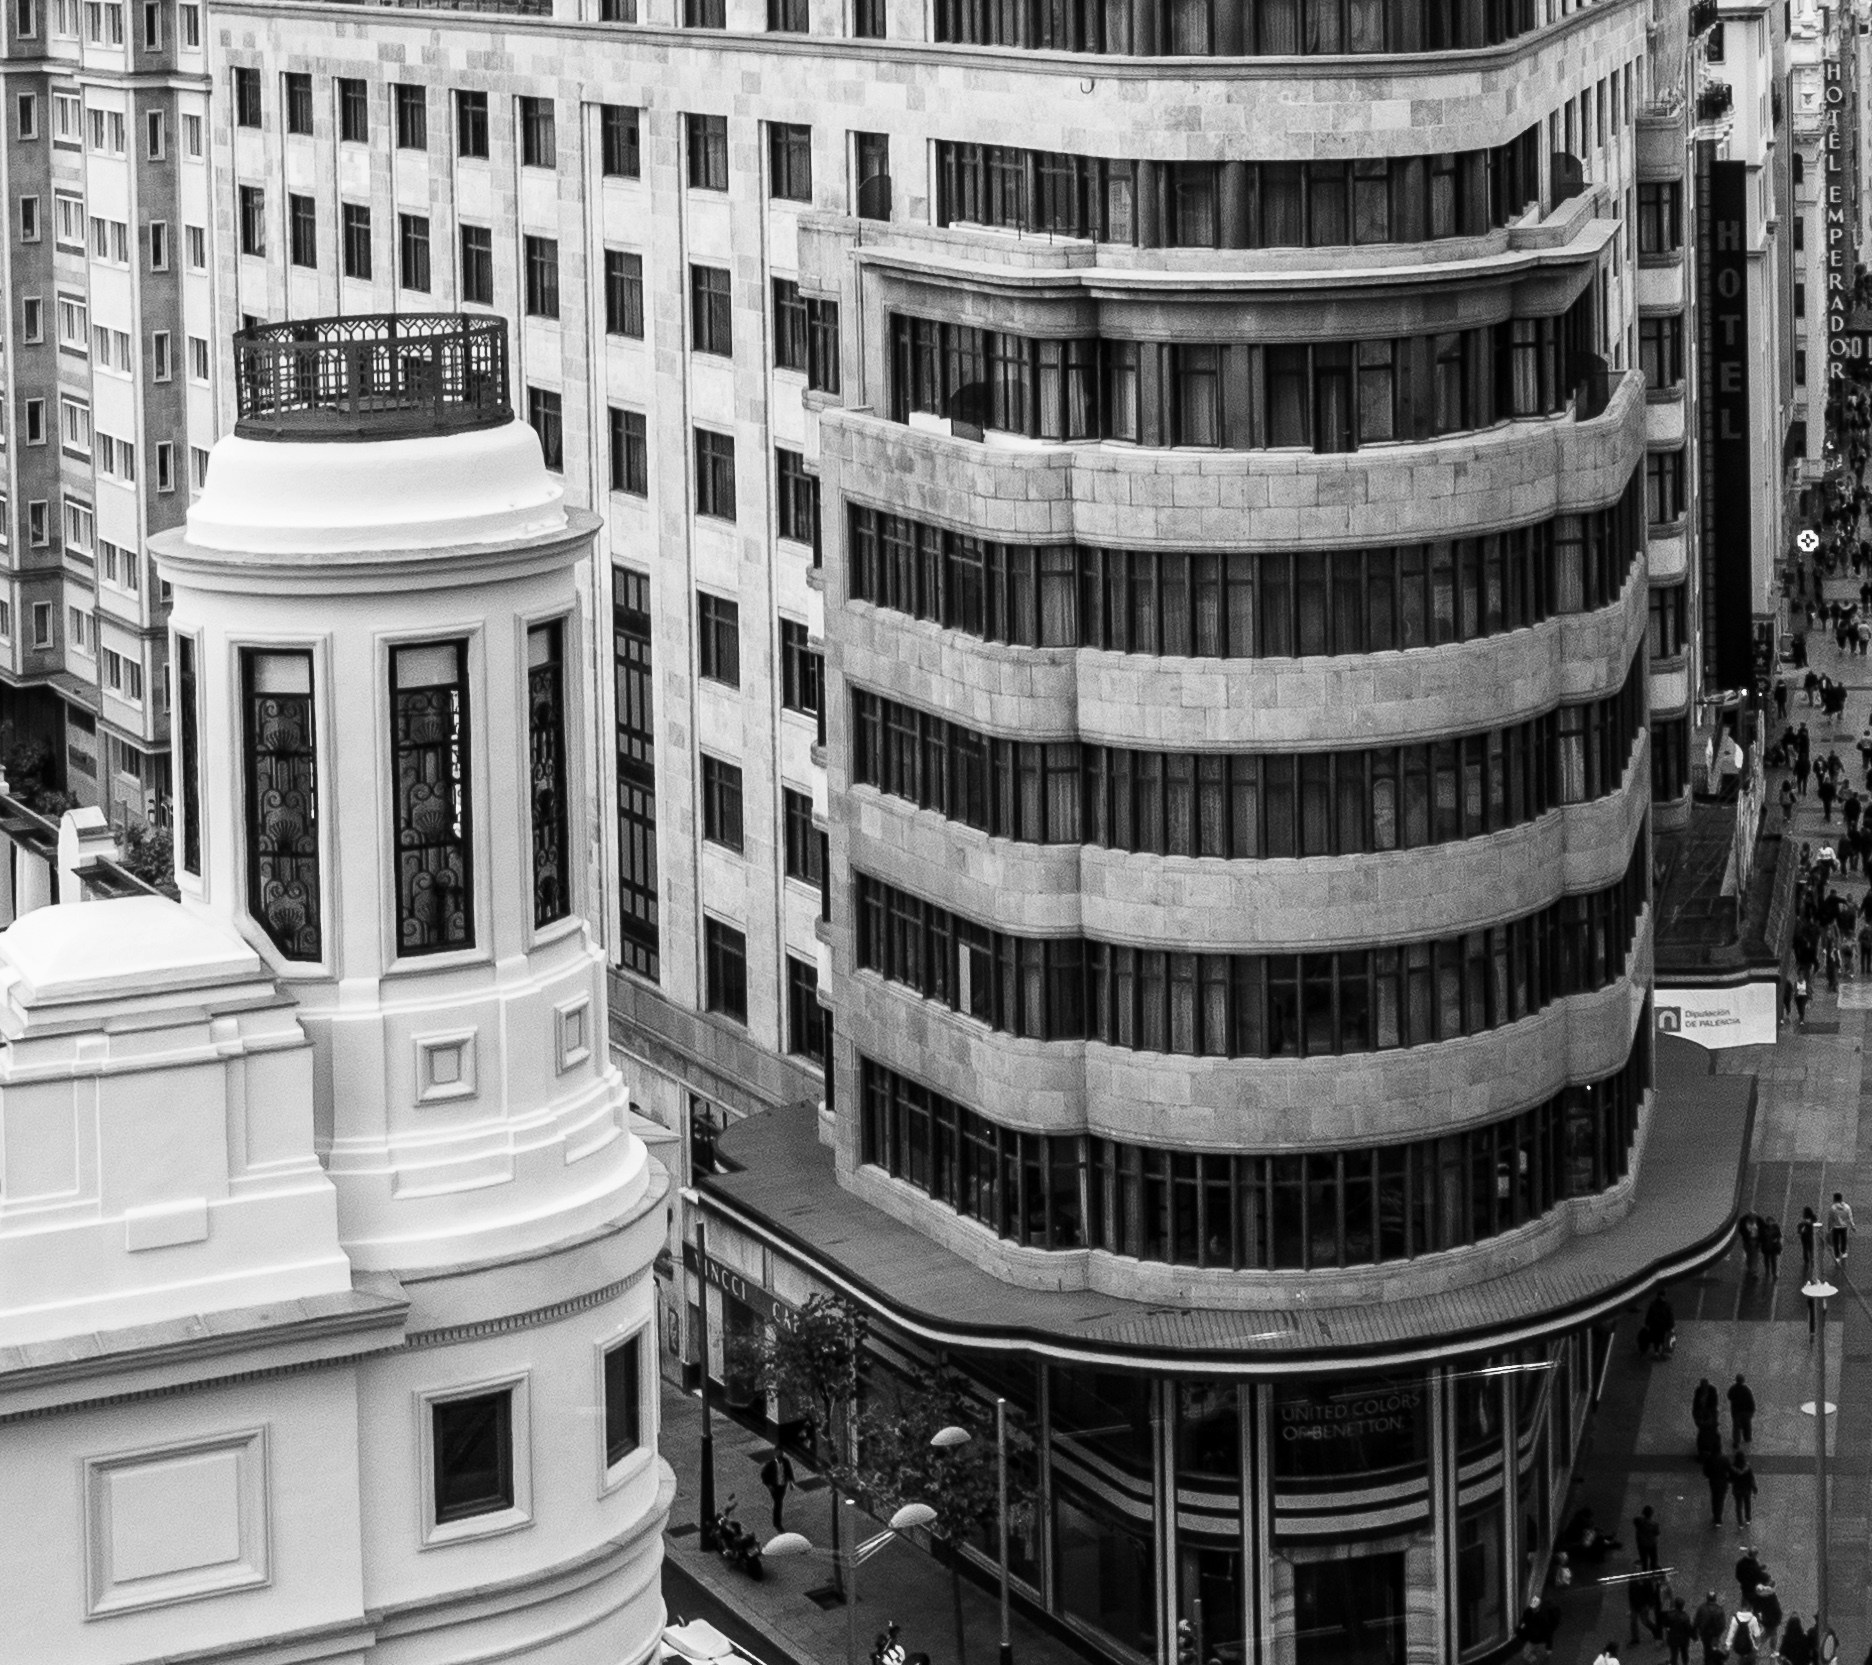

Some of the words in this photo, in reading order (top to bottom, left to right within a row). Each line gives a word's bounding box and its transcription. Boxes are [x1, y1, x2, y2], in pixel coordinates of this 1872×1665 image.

[1827, 63, 1843, 172] HOTEL
[1828, 186, 1845, 379] EMPERADOR
[1717, 220, 1742, 440] HOTEL
[1685, 1020, 1697, 1028] DE
[1699, 1018, 1741, 1028] PALENCIA
[1281, 1404, 1347, 1422] UNITED
[1352, 1392, 1421, 1417] COLORS
[1311, 1416, 1403, 1440] BENETTON
